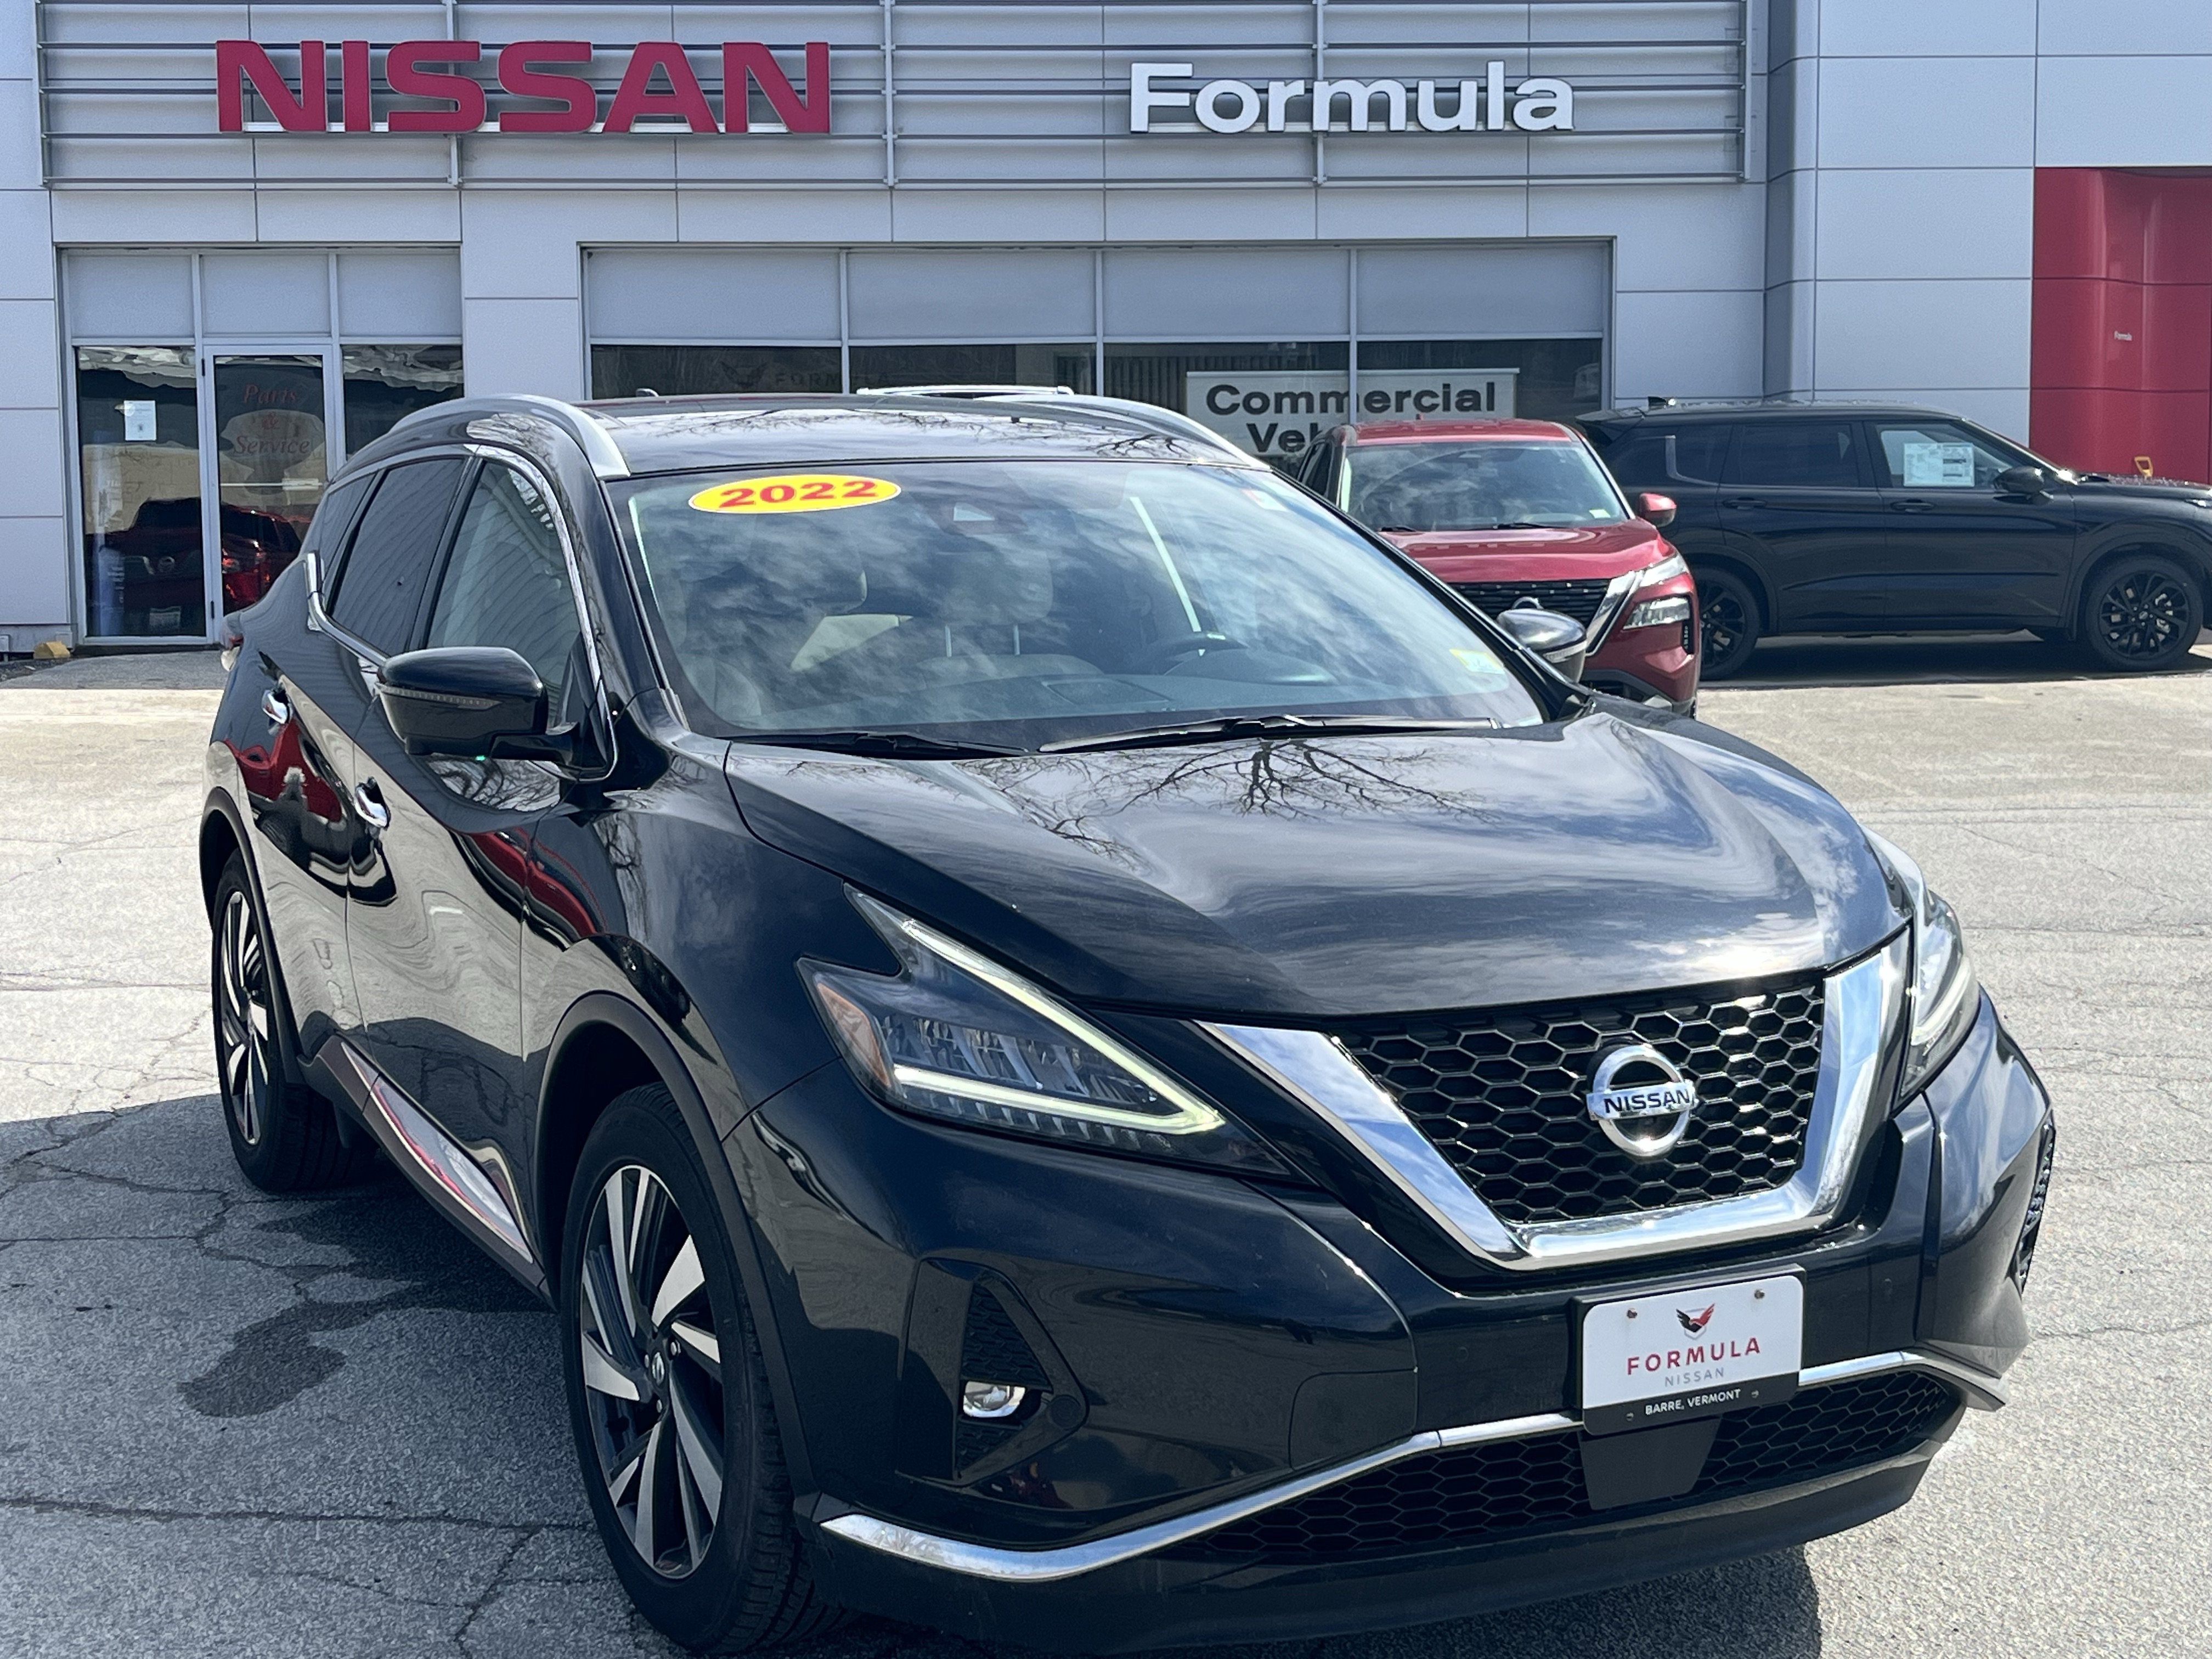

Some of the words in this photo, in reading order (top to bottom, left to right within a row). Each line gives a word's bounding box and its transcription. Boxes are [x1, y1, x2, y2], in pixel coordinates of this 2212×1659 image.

[215, 40, 831, 134] NISSAN
[1129, 60, 1575, 134] Formula
[242, 383, 298, 404] Parts
[1206, 382, 1495, 415] Commercial
[262, 411, 280, 430] &
[234, 435, 311, 455] Service
[719, 480, 878, 508] 2022
[1604, 1088, 1691, 1114] NISSAN
[1627, 1338, 1760, 1375] FORMULA
[1664, 1368, 1725, 1387] NISSAN
[1645, 1399, 1685, 1416] BARRE,
[1687, 1389, 1741, 1407] VERMONT
